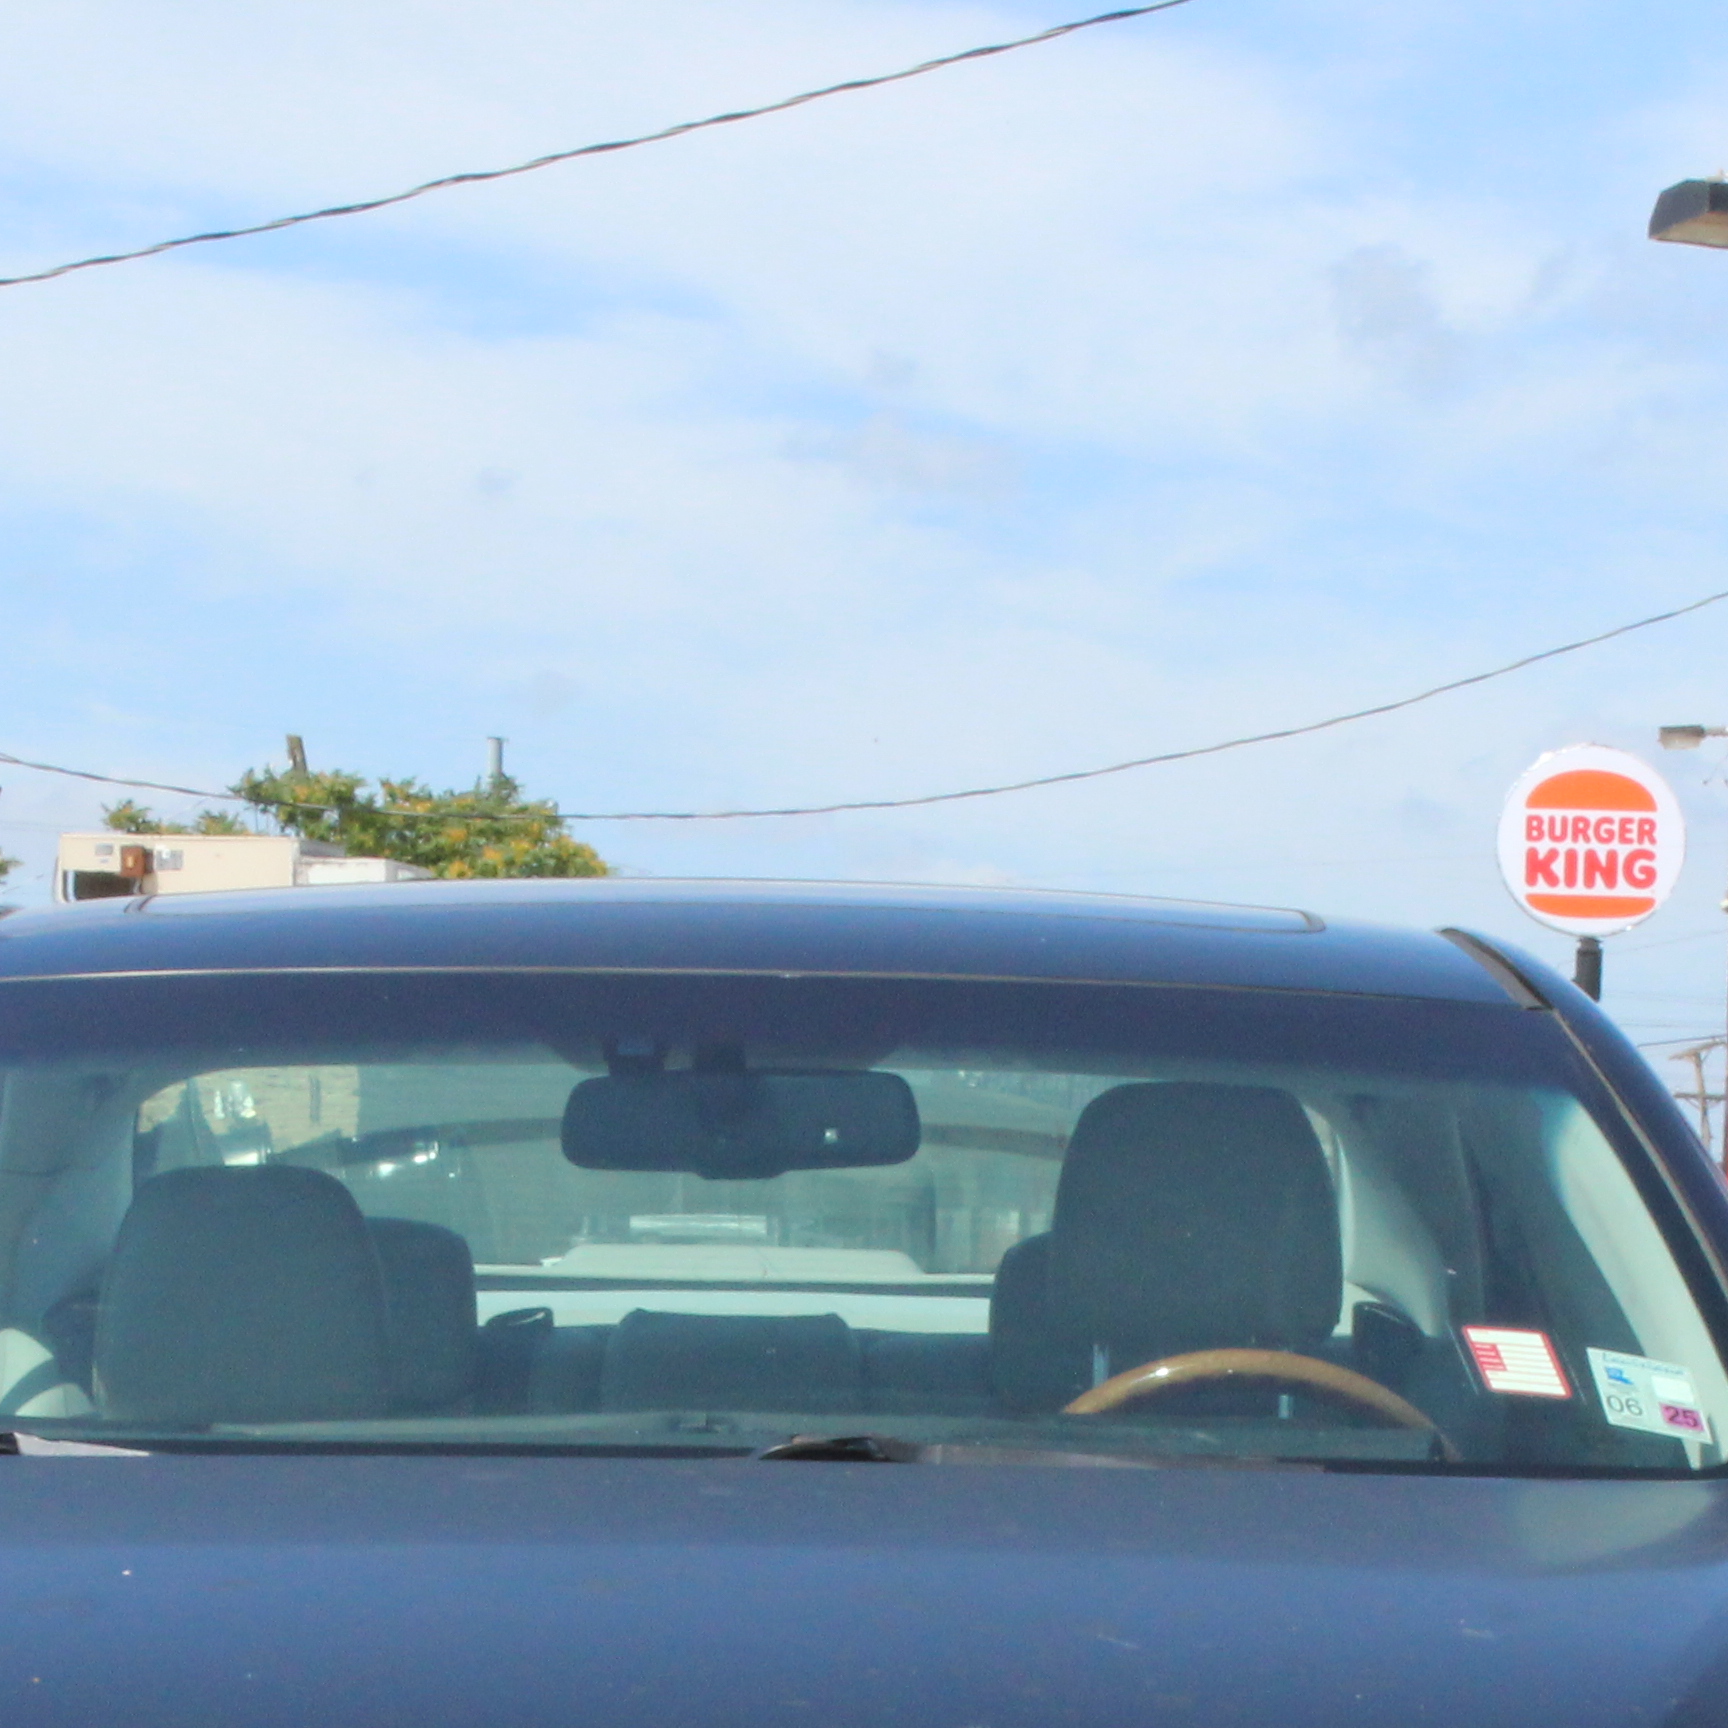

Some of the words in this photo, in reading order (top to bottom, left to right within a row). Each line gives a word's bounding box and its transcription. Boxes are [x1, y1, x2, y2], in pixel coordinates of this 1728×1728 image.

[1525, 814, 1657, 846] BURGER
[1525, 847, 1657, 890] KING
[1606, 1394, 1644, 1417] 06
[1664, 1404, 1699, 1428] 25
